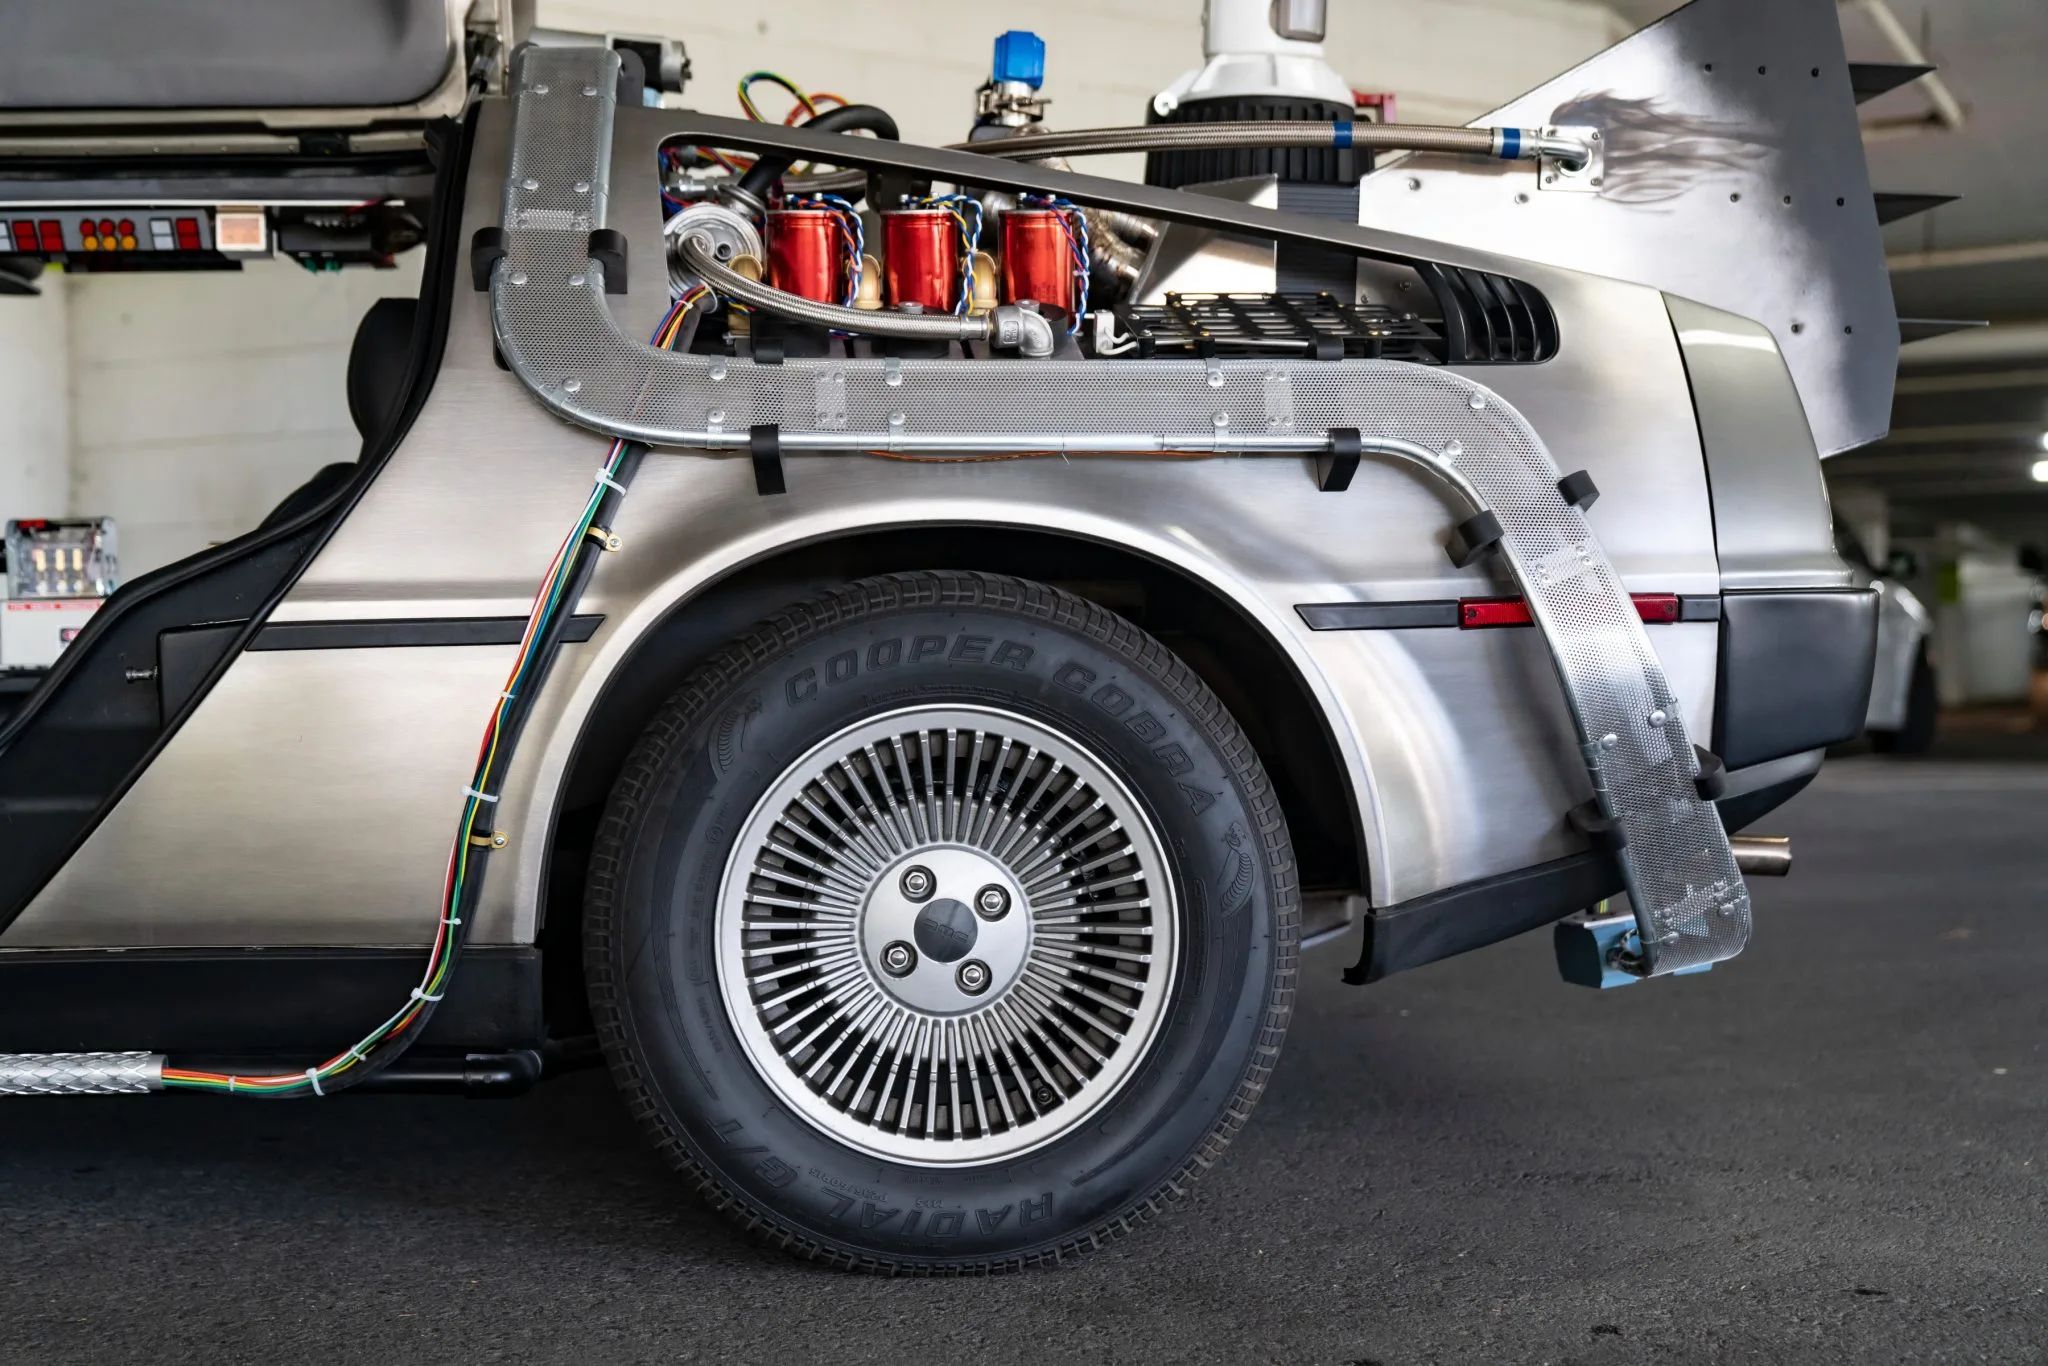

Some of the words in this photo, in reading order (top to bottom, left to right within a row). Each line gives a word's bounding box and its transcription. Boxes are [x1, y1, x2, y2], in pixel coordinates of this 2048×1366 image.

[784, 634, 1035, 708] COOPER
[1053, 662, 1216, 817] COBRA
[705, 1117, 799, 1190] G/T
[820, 1187, 1054, 1240] RADIAL
